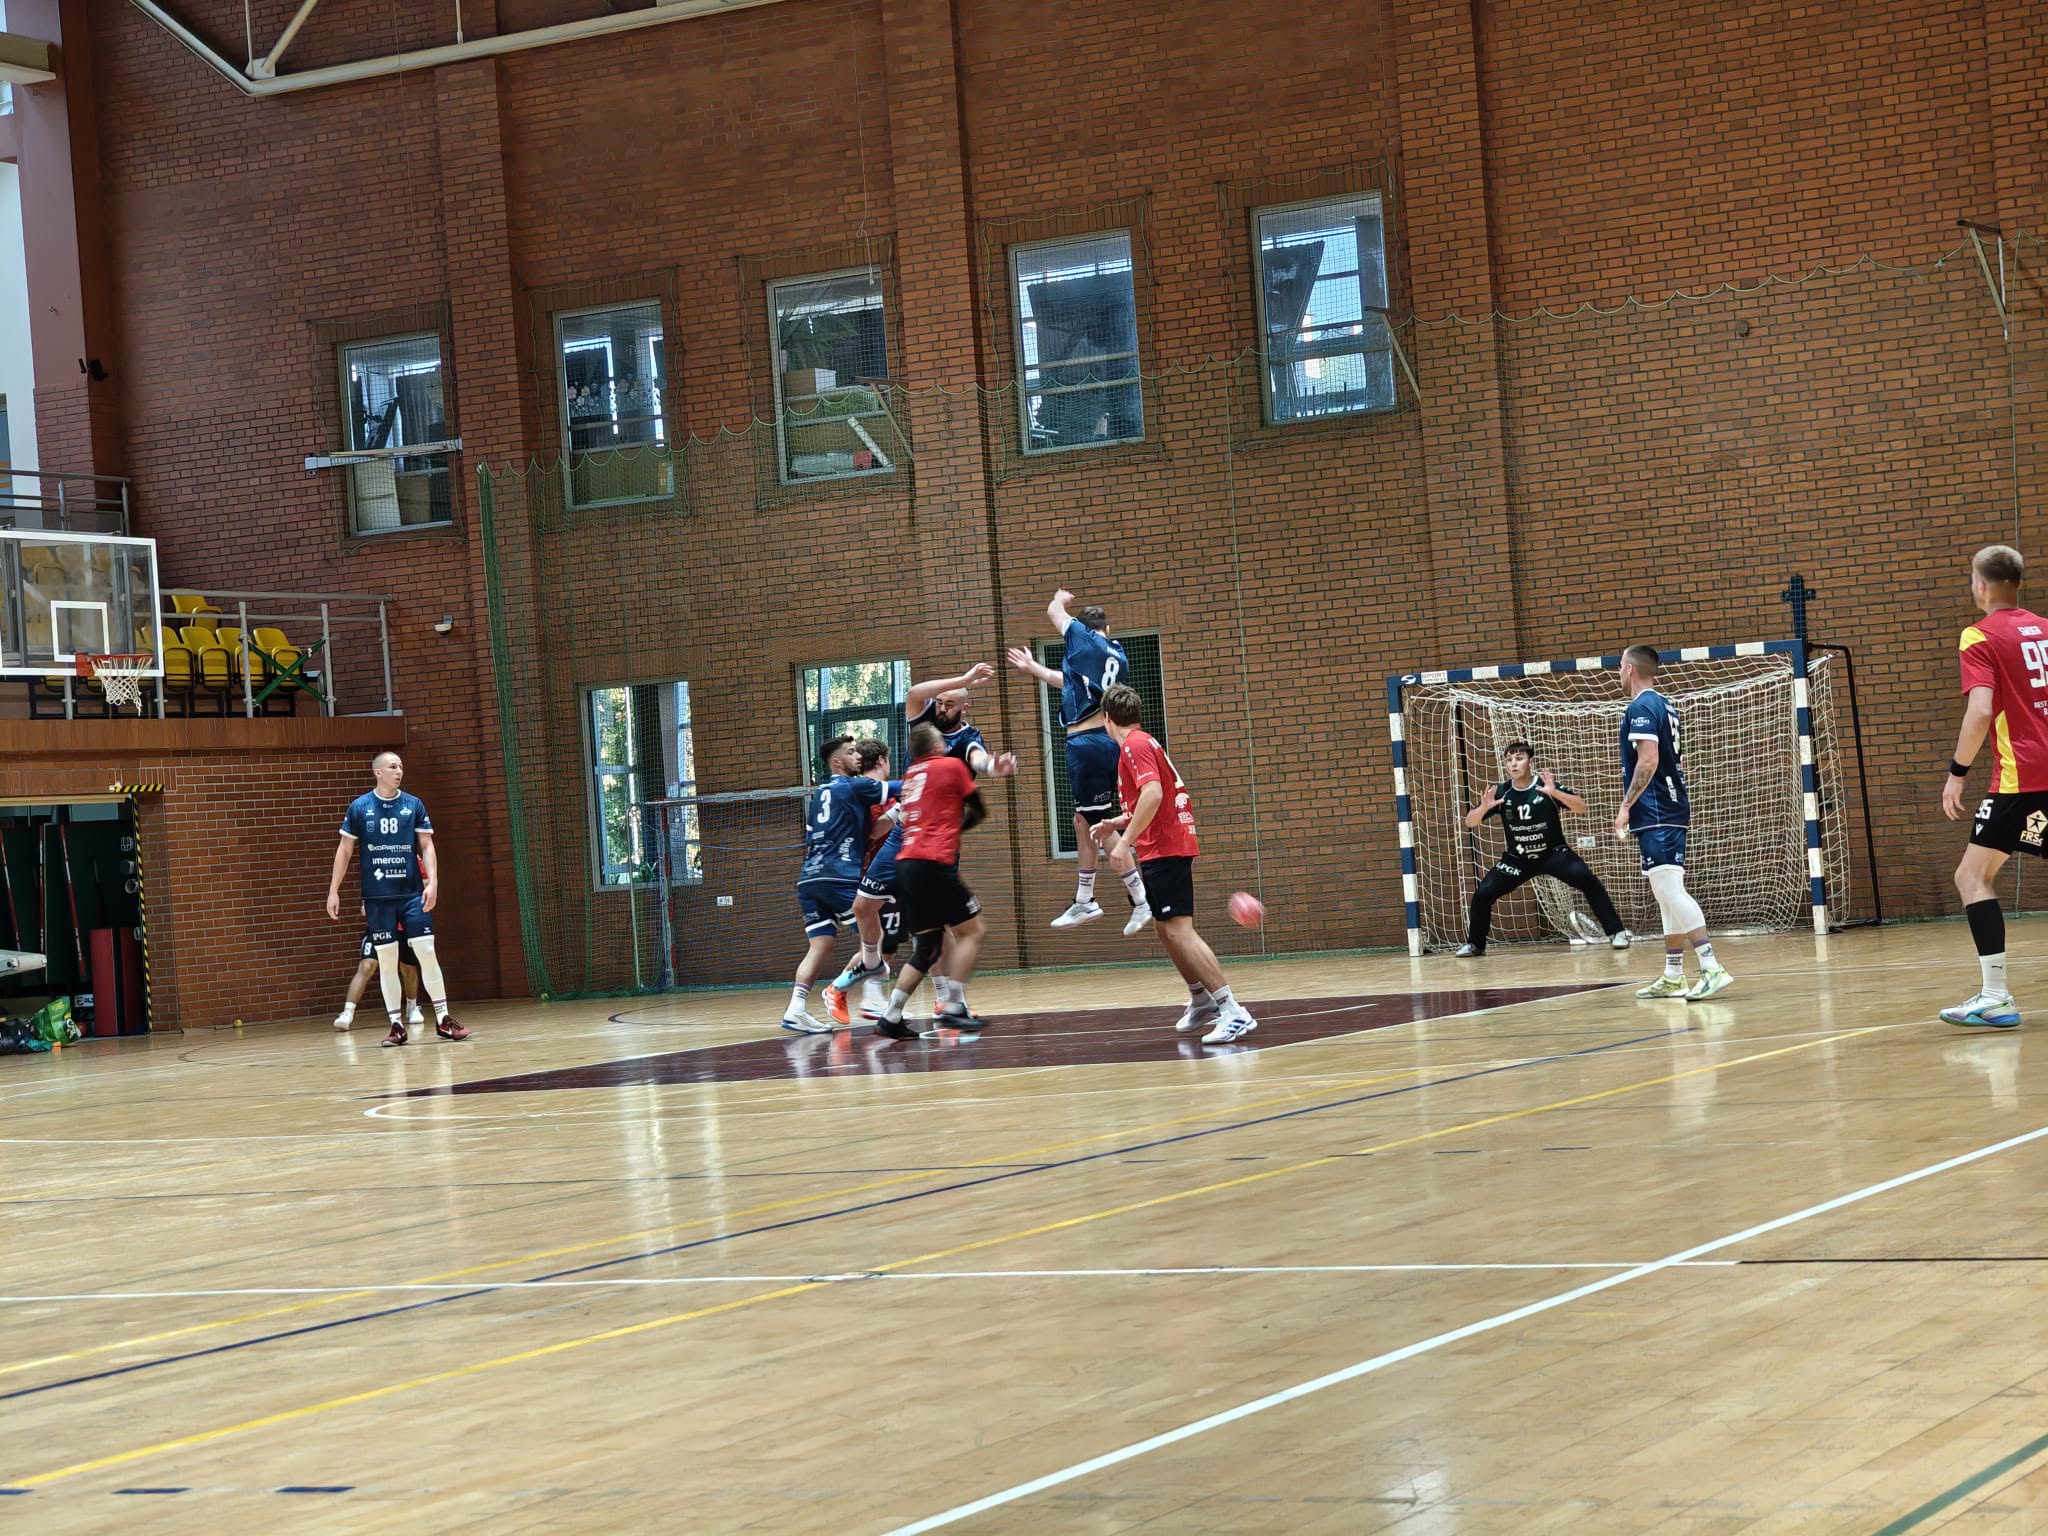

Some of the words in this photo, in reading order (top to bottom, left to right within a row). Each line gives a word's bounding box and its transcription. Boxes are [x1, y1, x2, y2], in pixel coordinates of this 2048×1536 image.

[1101, 656, 1119, 691] 8
[817, 789, 831, 823] 3
[1517, 804, 1532, 820] 12
[380, 817, 398, 834] 88
